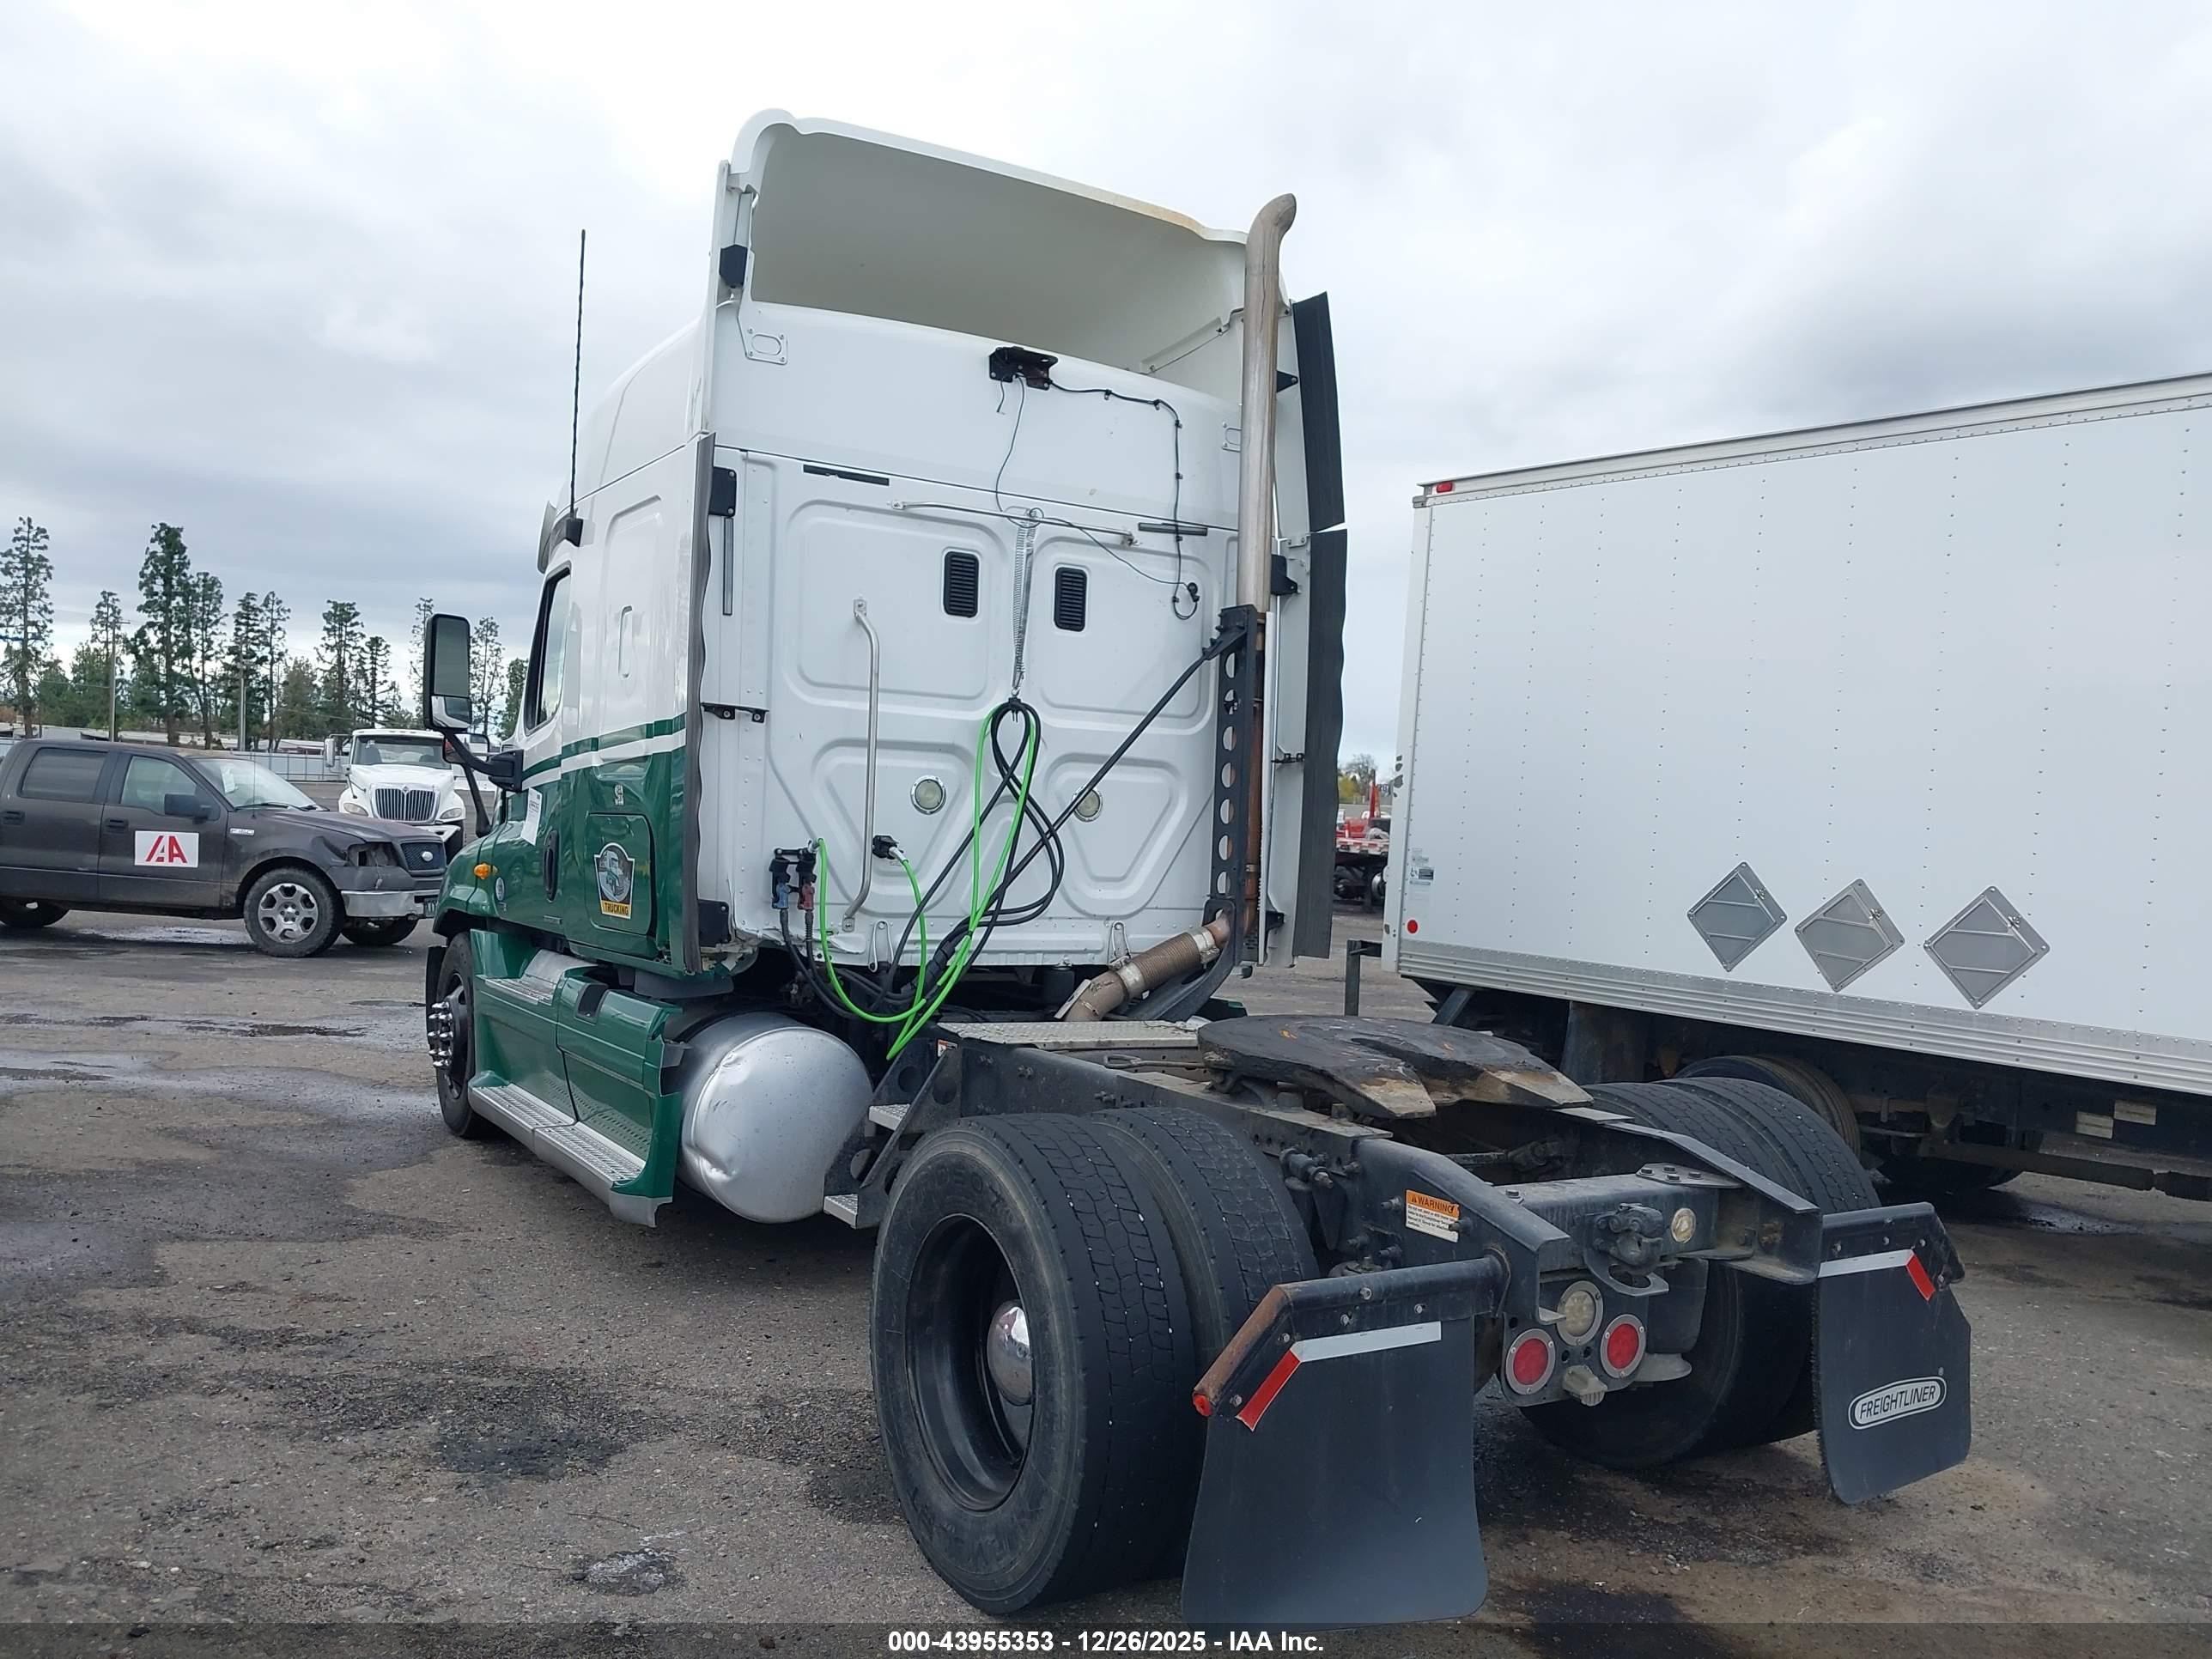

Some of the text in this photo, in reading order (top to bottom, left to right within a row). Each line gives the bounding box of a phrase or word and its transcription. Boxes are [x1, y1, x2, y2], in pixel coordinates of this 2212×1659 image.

[604, 902, 629, 915] TRUCKING
[1418, 1194, 1455, 1214] WARNING
[1859, 1384, 1936, 1419] FREIGHTLINER
